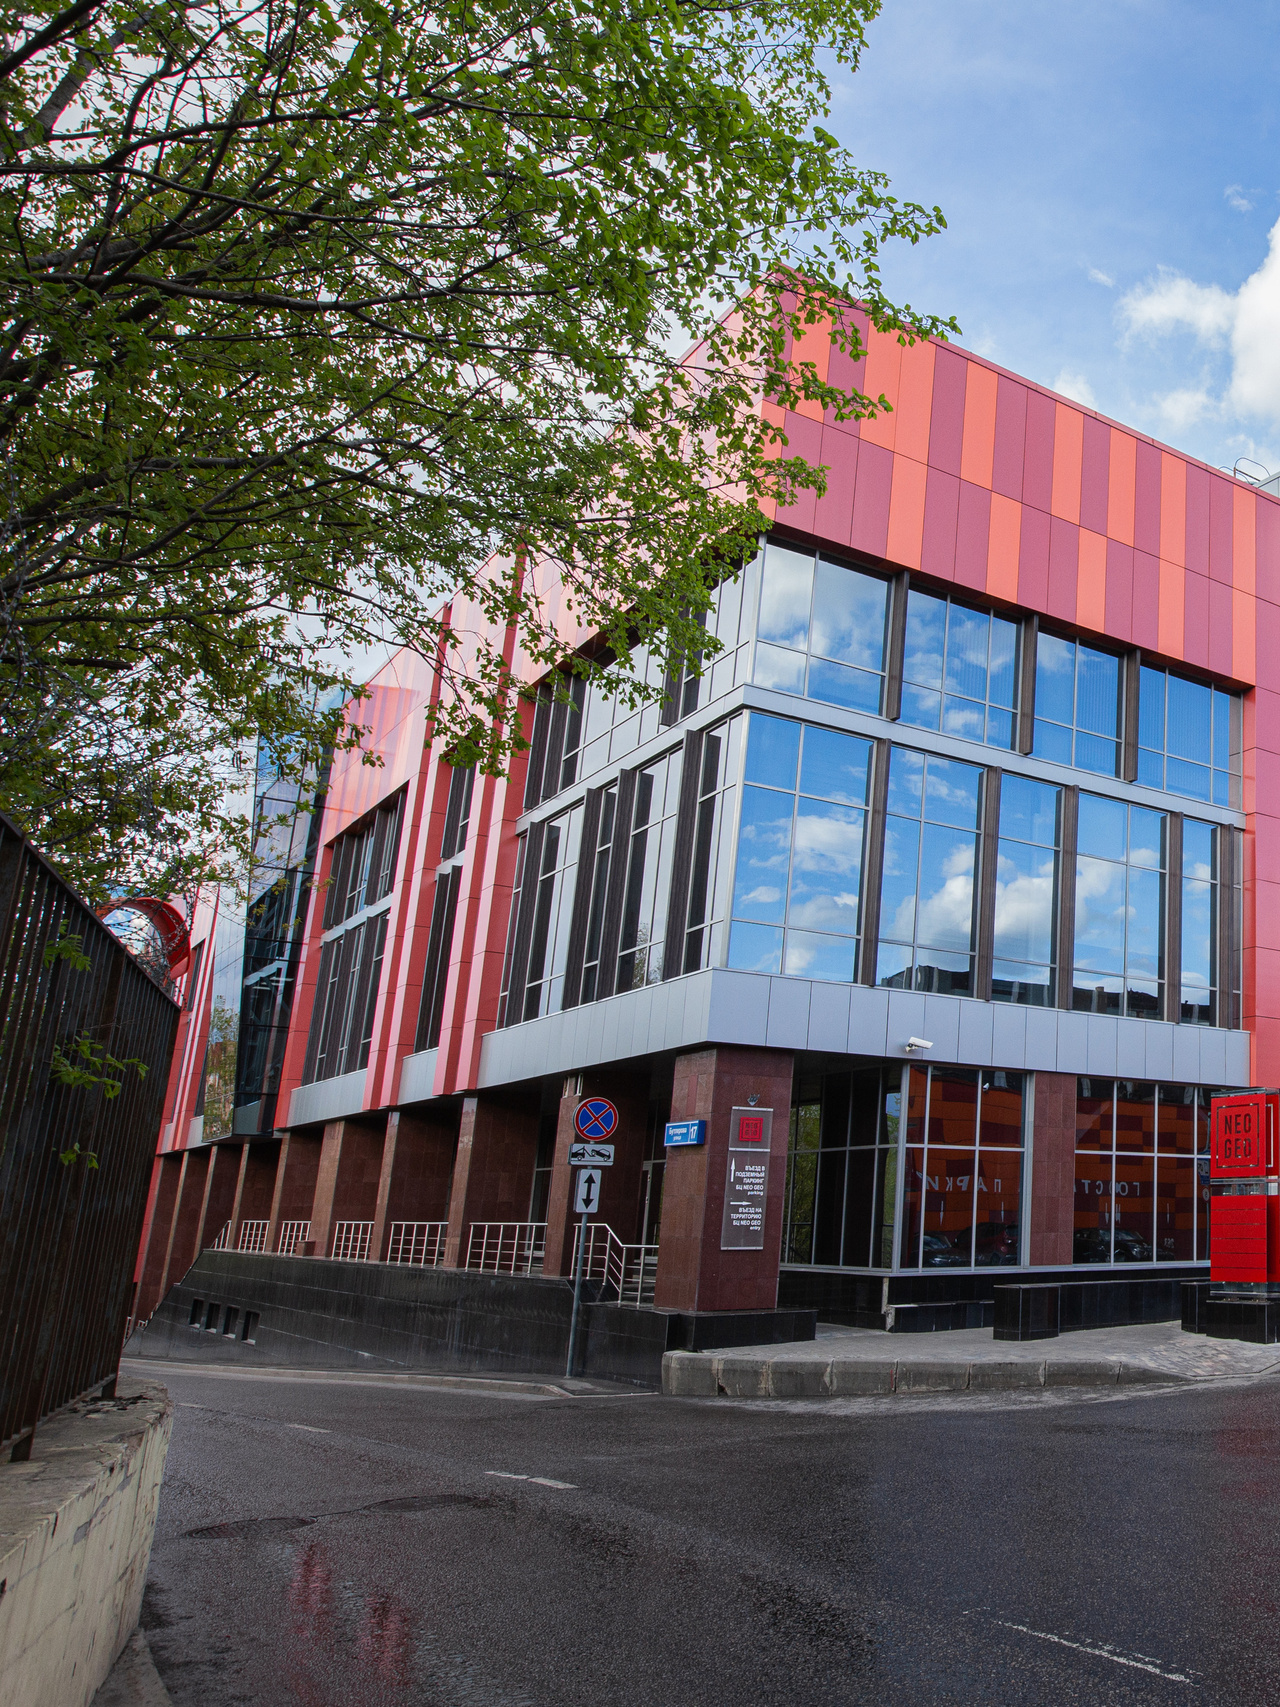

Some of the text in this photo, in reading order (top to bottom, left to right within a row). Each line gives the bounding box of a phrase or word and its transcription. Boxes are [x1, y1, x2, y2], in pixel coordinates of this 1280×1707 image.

[690, 1126, 698, 1139] 17
[1224, 1113, 1252, 1135] NEO
[1224, 1138, 1252, 1159] GEO
